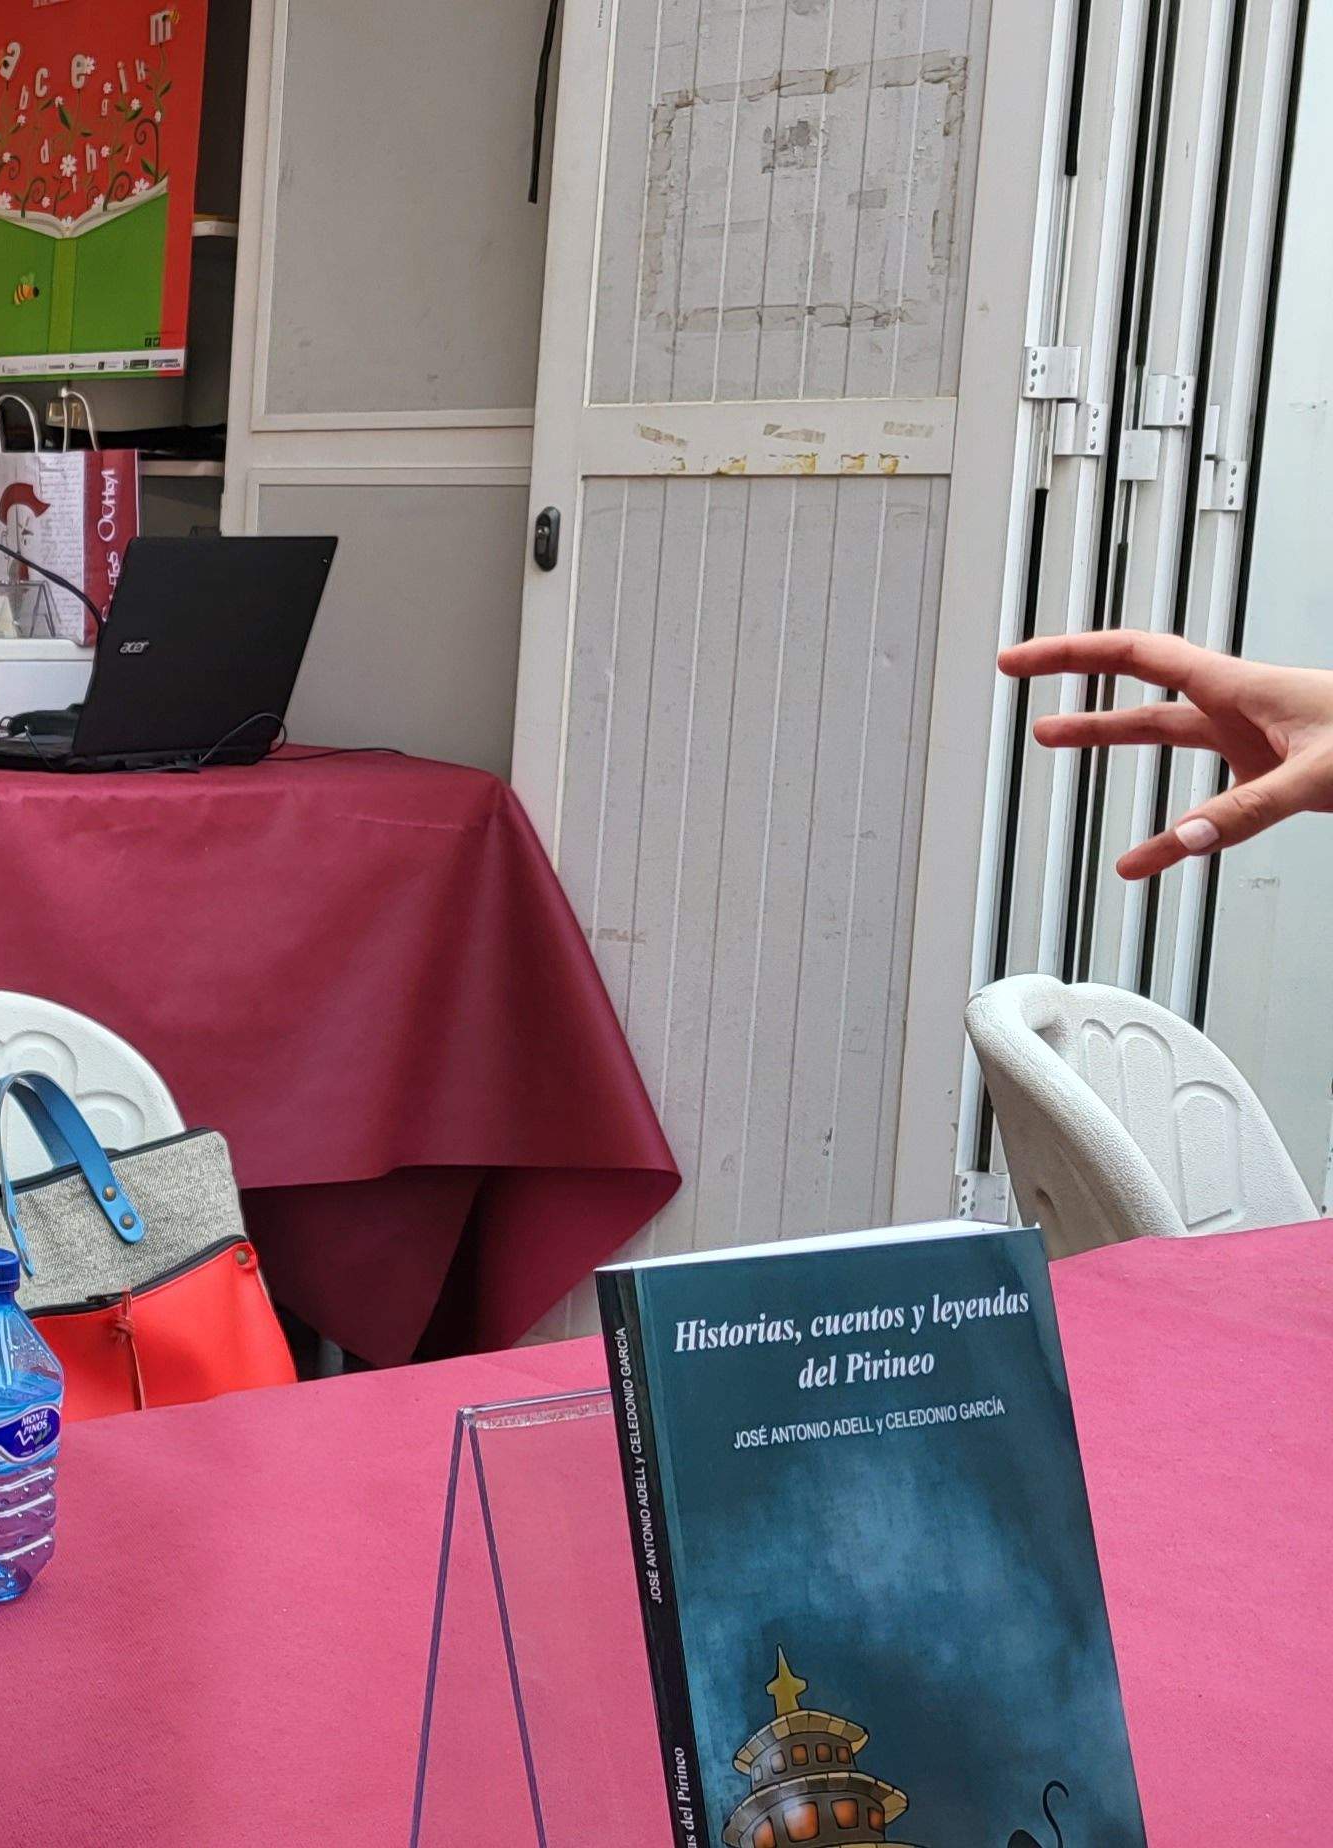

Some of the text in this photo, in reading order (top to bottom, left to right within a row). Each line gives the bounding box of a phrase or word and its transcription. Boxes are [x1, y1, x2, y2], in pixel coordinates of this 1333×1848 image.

[120, 640, 149, 653] acer
[673, 1286, 1030, 1352] Historias, cuentos y leyendas
[615, 1327, 632, 1377] GARCÍA
[798, 1350, 935, 1389] del Pirineo
[21, 1409, 48, 1426] MONTE
[23, 1419, 48, 1435] PINOS
[623, 1379, 642, 1454] CELEDONIO
[733, 1395, 1006, 1450] JOSÉ ANTONIO ADELL y CELEDONIO GARCÍA
[634, 1466, 650, 1507] ADELL
[640, 1508, 658, 1568] ANTONIO
[645, 1569, 663, 1604] JOSÉ
[674, 1747, 691, 1802] Pirineo
[677, 1806, 695, 1831] del
